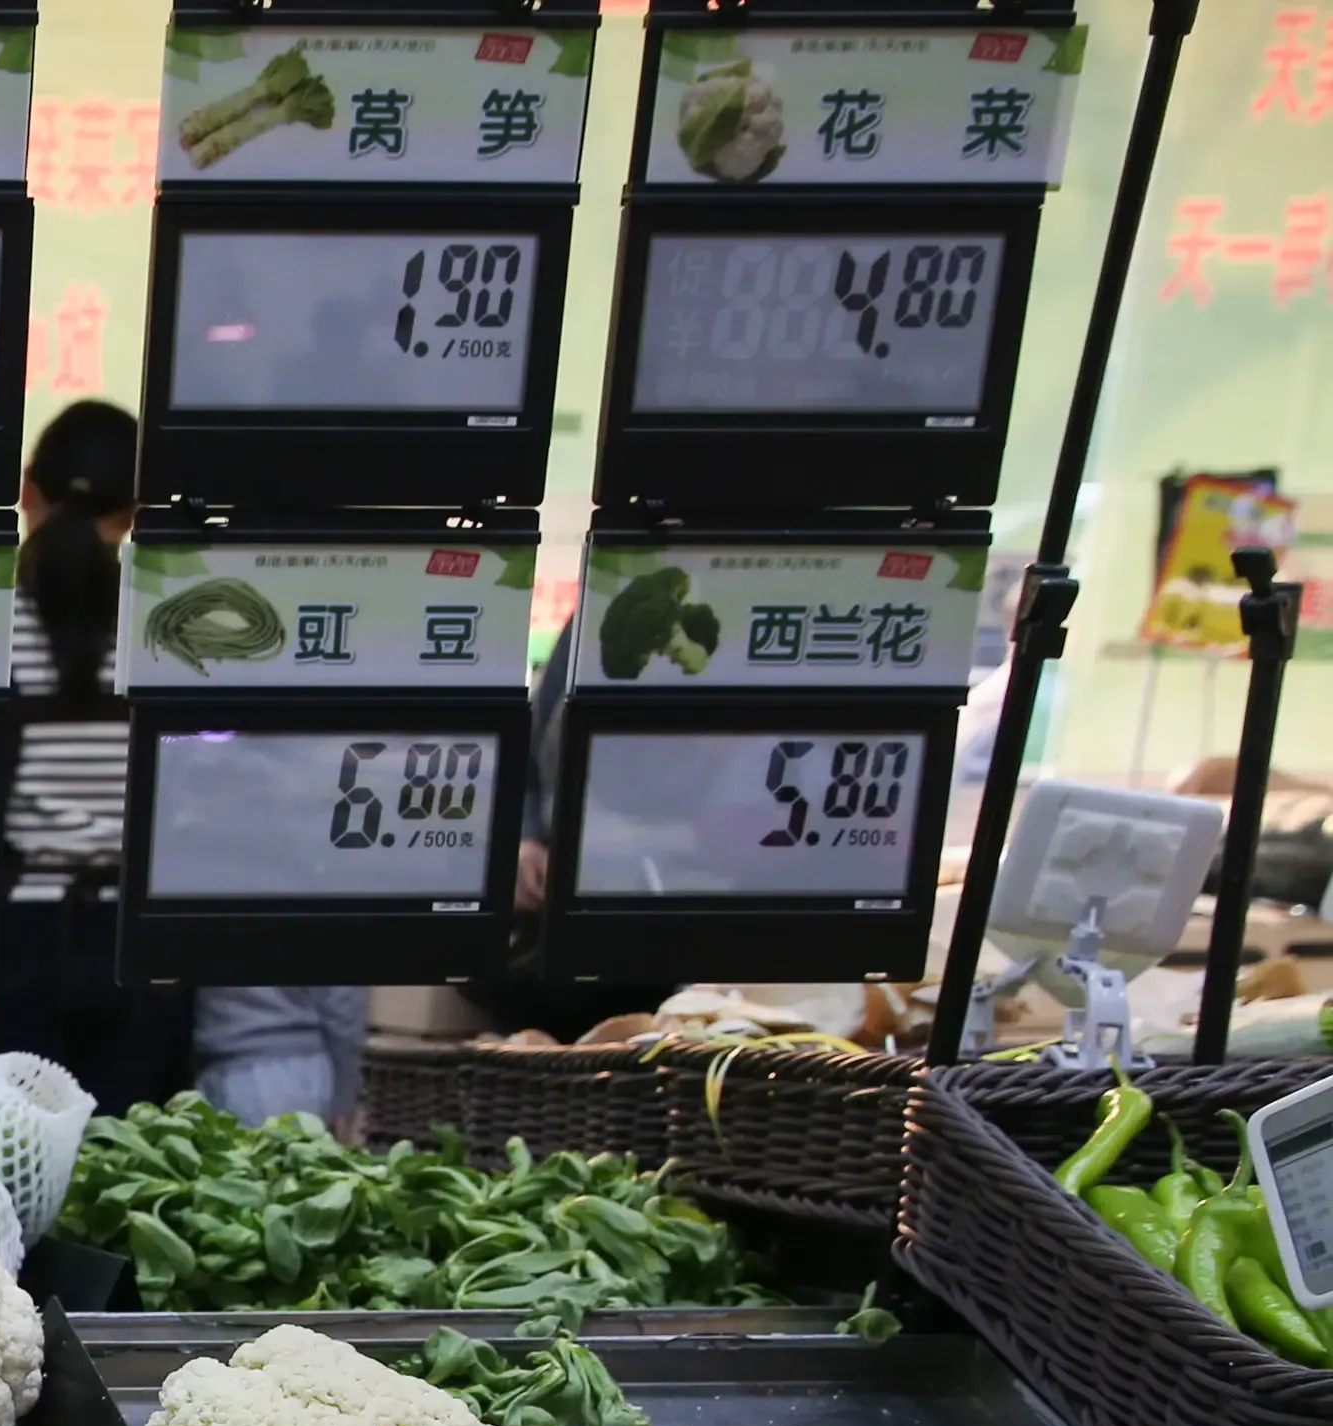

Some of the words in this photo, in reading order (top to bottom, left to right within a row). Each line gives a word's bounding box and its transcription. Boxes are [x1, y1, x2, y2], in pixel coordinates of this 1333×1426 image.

[349, 89, 541, 154] 莴笋
[818, 89, 1031, 154] 花菜
[394, 245, 521, 358] 1.90
[835, 245, 986, 359] 4.80
[295, 605, 479, 660] 豇豆
[748, 603, 925, 662] 西兰花
[330, 742, 482, 849] 6.80
[759, 741, 909, 847] 5.80
